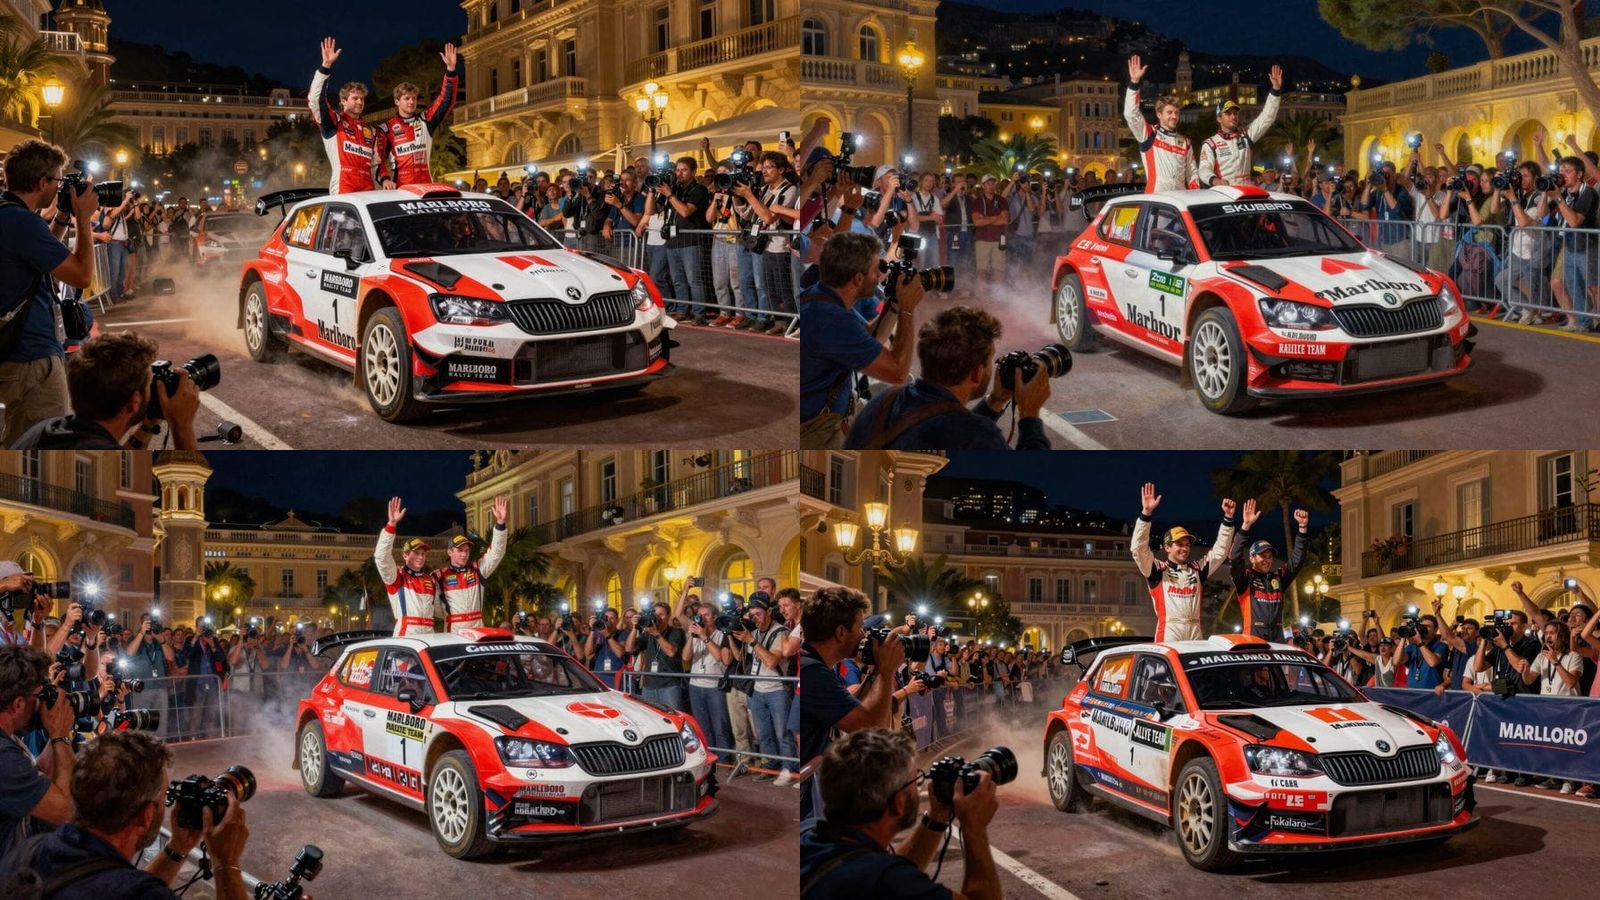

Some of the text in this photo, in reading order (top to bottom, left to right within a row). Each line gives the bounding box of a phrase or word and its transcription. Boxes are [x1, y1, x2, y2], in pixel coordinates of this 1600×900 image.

[399, 199, 493, 211] MARLBORO
[1322, 278, 1423, 302] Marlboro
[332, 298, 338, 324] 1
[1160, 294, 1166, 318] 1
[317, 319, 357, 351] Marlboro
[1307, 344, 1326, 355] TEAM
[448, 363, 497, 374] MARLBORO
[386, 711, 426, 730] MARLBORO
[1499, 721, 1588, 746] MARLLORO
[400, 737, 406, 766] 1
[1129, 746, 1135, 766] 1
